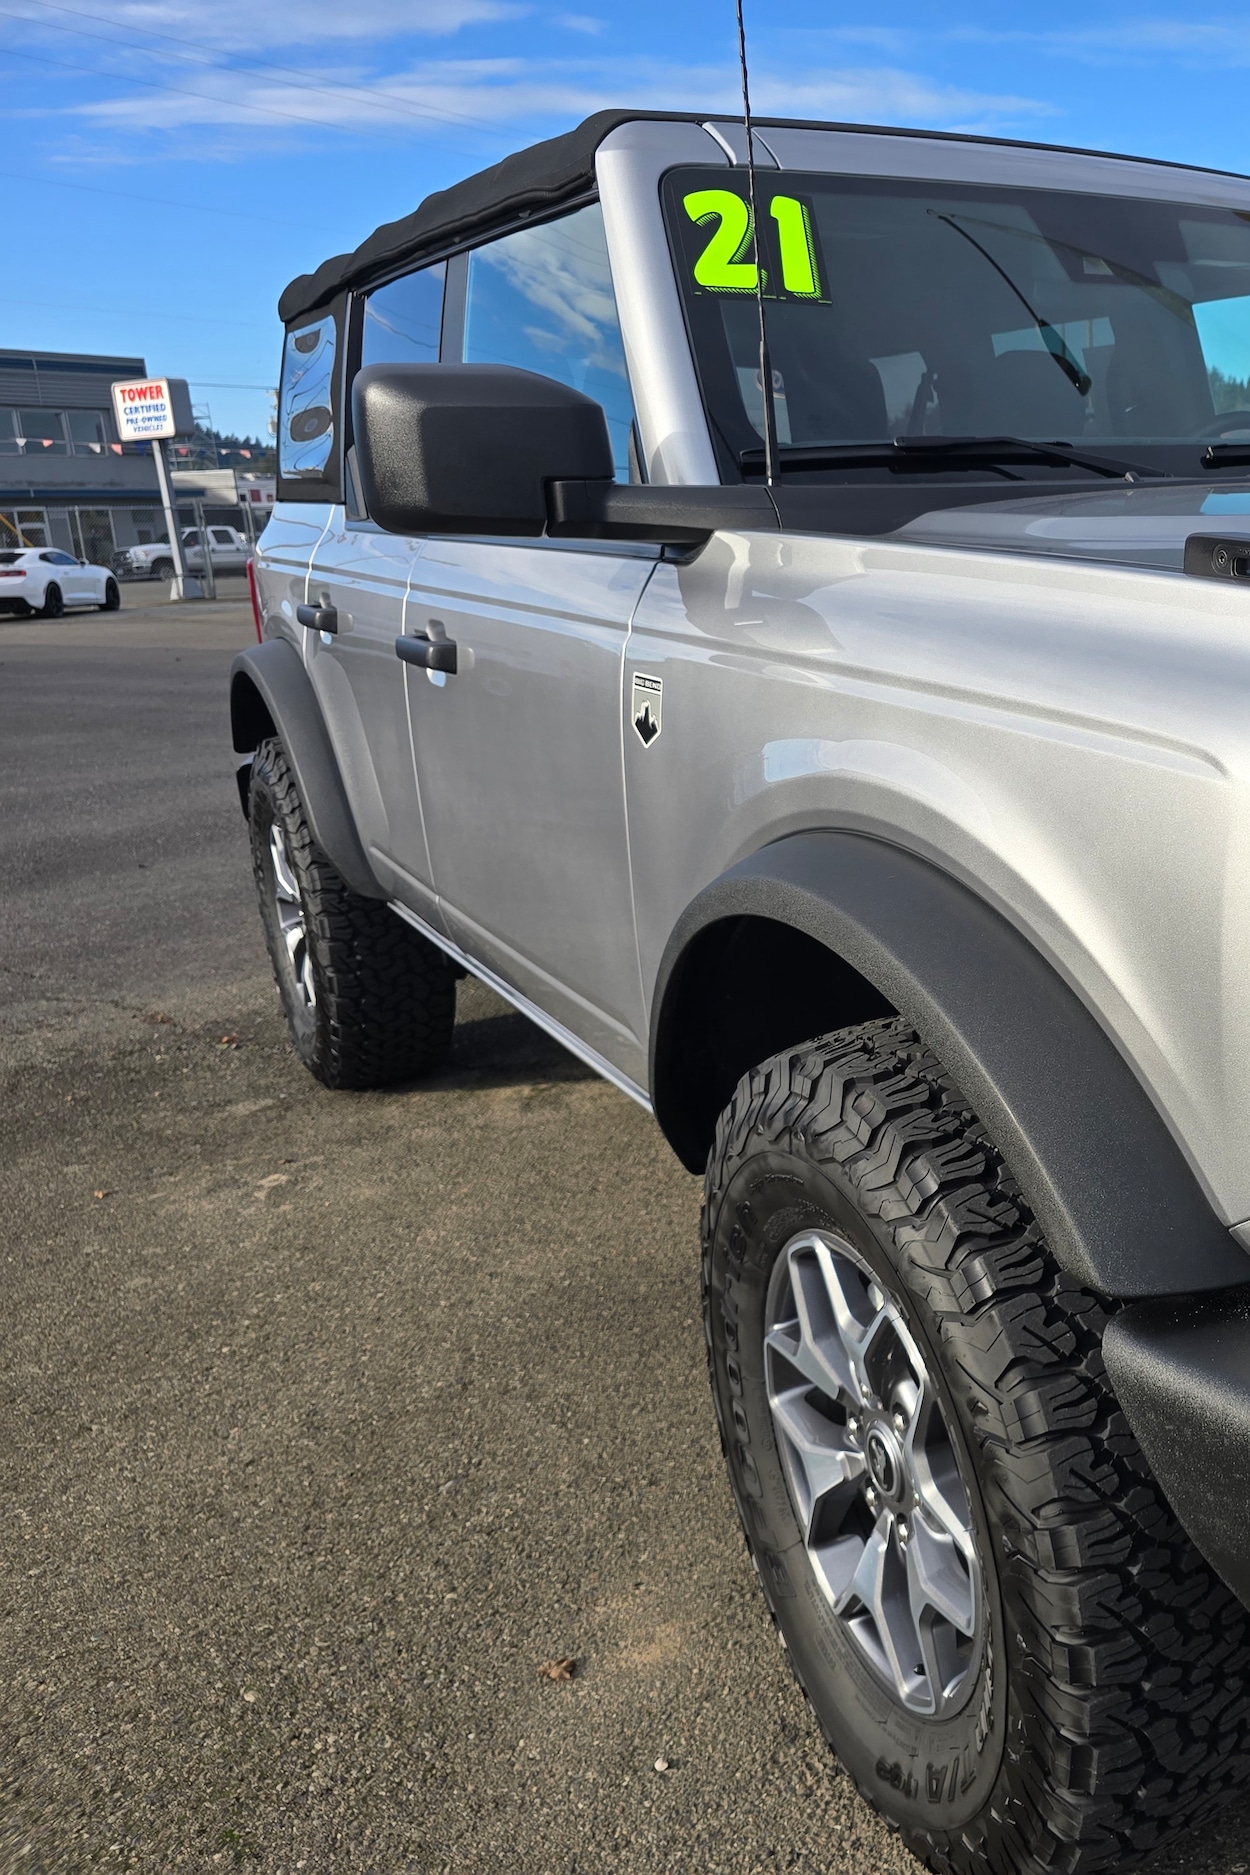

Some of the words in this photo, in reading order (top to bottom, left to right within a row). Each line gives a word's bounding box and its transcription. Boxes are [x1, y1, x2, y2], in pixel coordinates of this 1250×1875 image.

[683, 189, 819, 297] 21
[120, 385, 164, 403] TOWER
[123, 403, 166, 415] CERTIFIED
